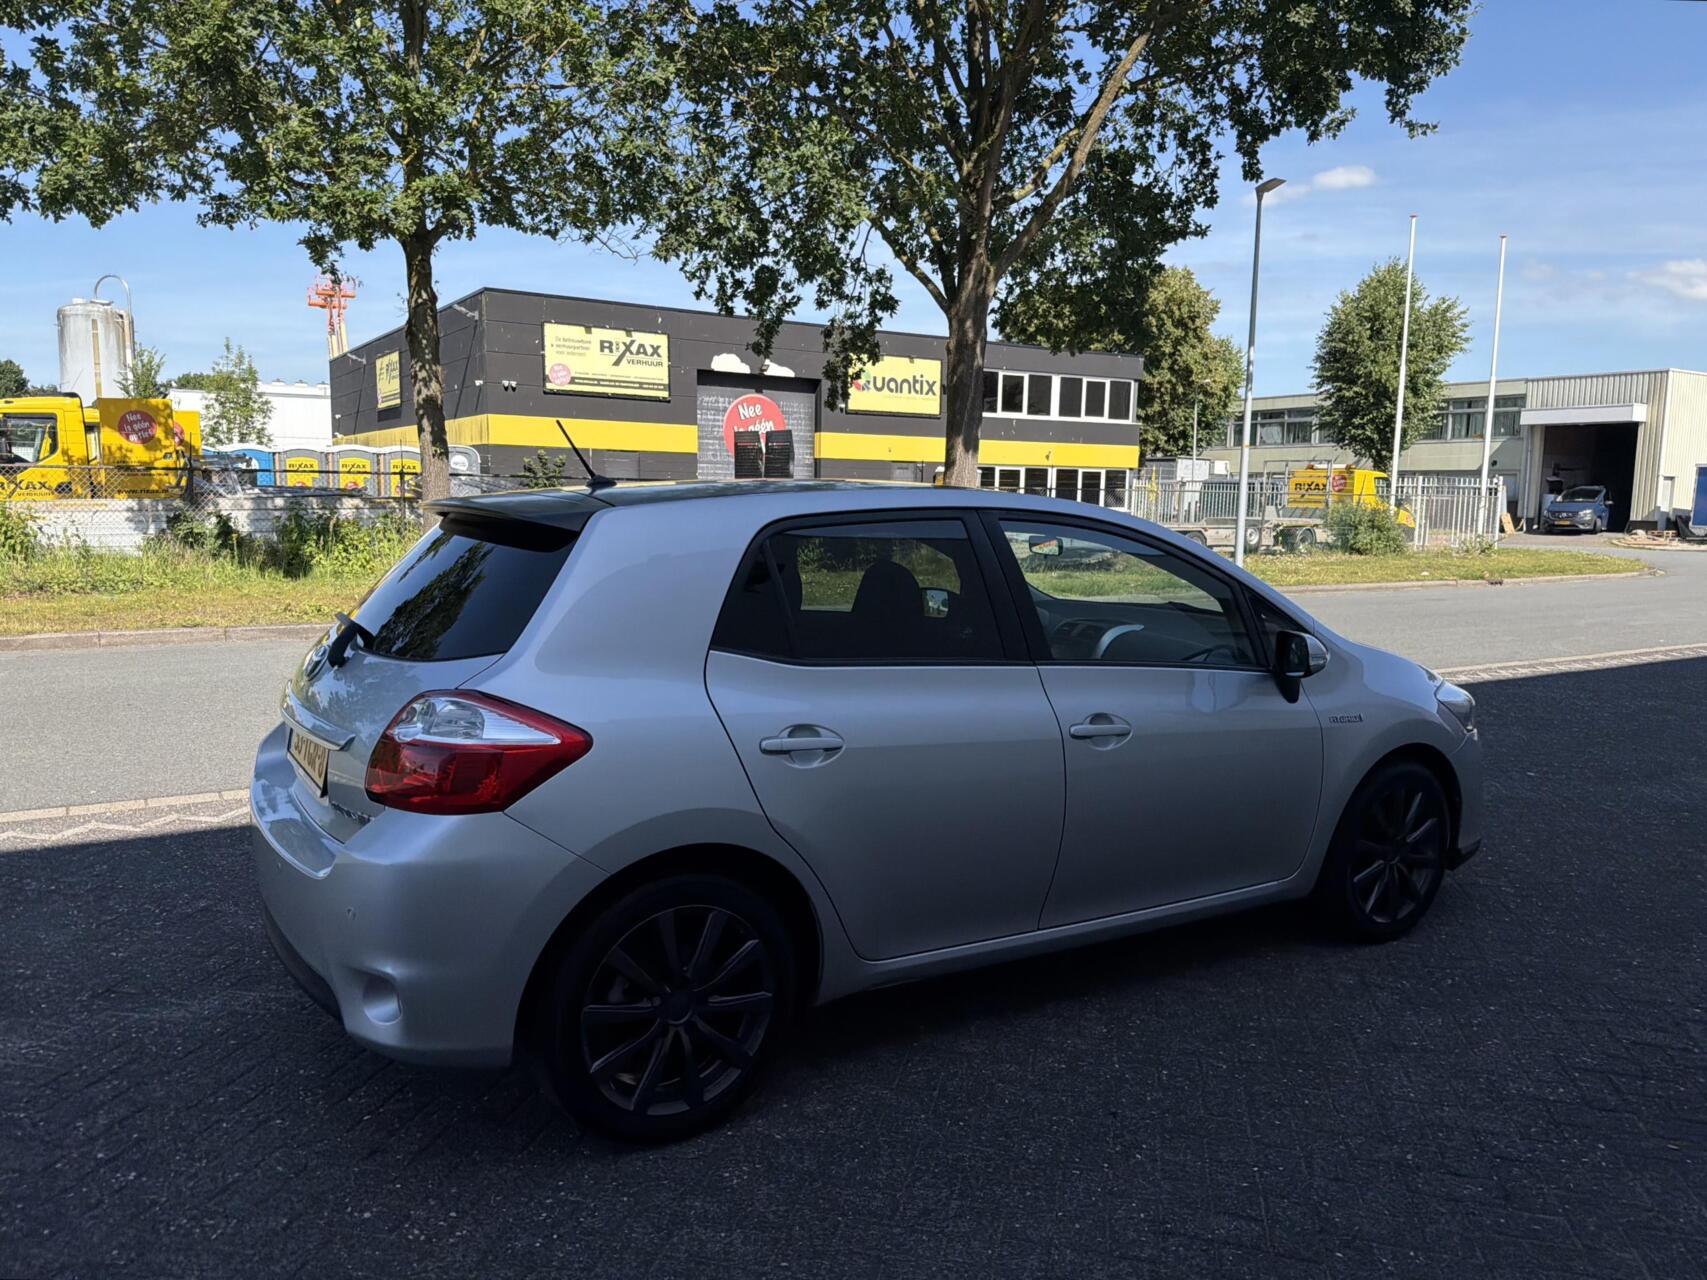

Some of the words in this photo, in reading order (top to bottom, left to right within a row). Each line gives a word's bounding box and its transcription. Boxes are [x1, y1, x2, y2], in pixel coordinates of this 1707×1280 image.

[626, 358, 663, 368] VERHUUR
[737, 402, 762, 420] Nee
[126, 413, 141, 422] Nee
